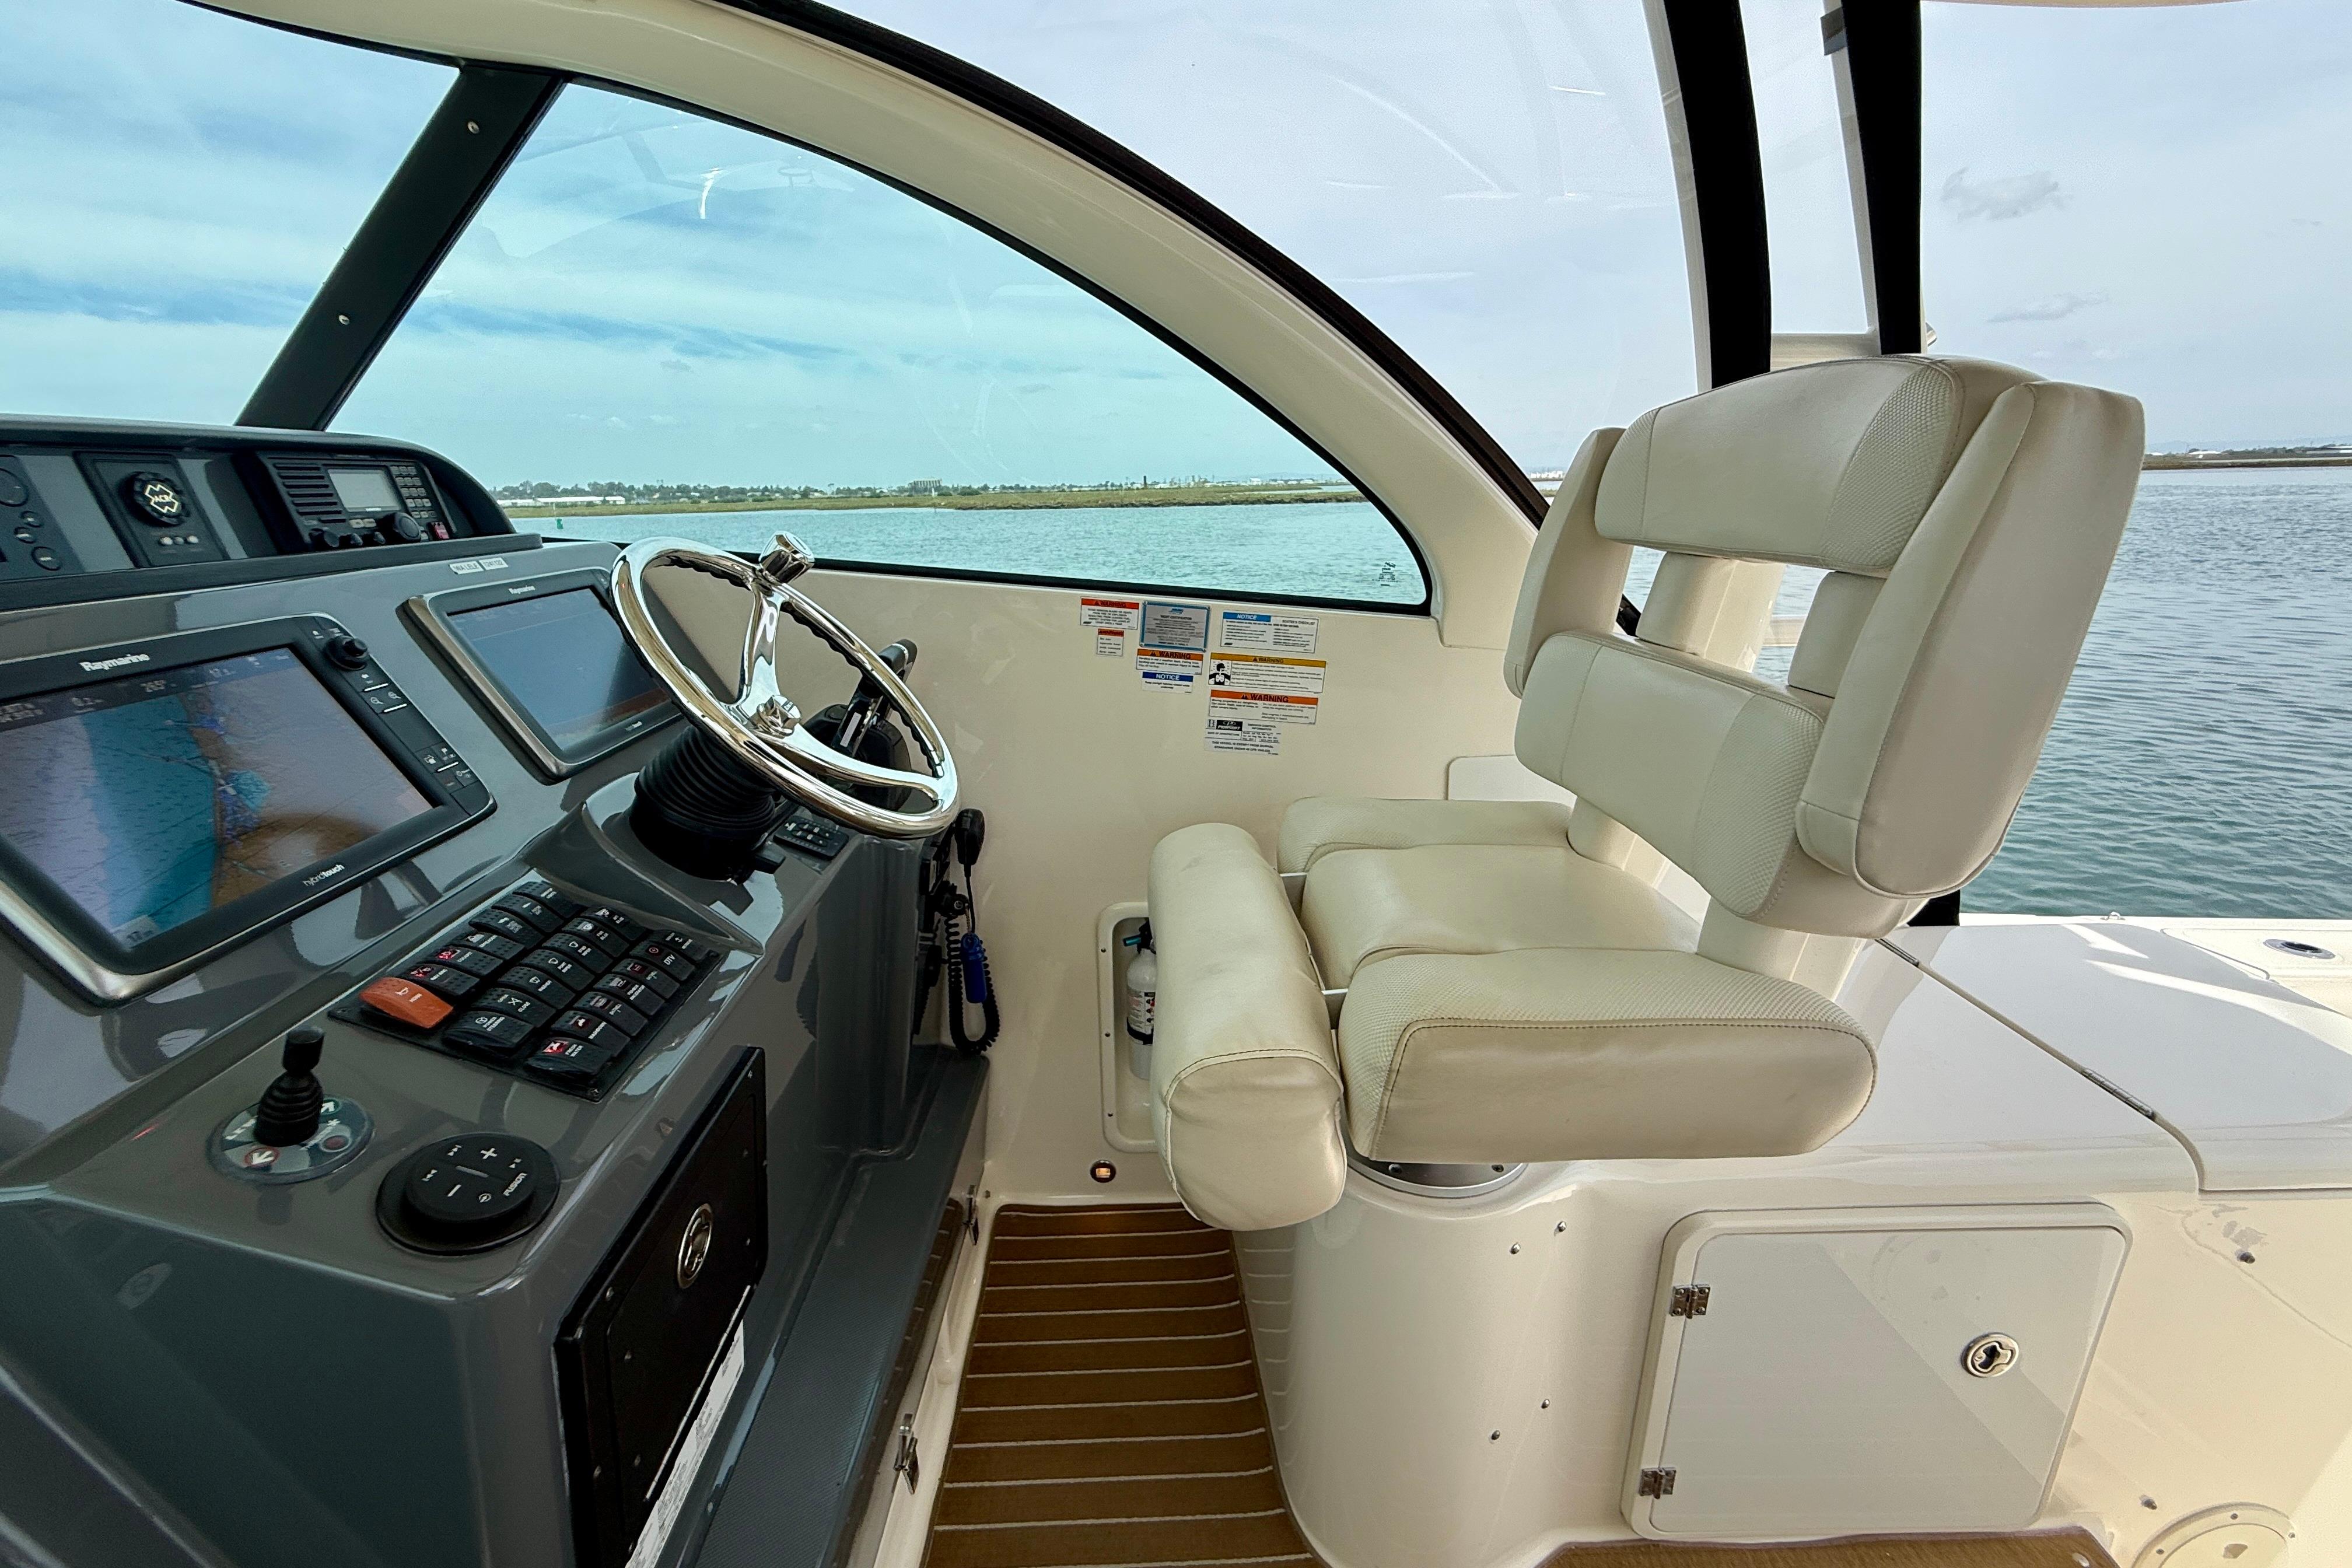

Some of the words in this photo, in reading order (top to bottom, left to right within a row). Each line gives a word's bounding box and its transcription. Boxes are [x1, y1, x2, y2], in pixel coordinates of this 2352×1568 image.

[1158, 650, 1191, 659] WARNING
[79, 653, 150, 671] Raymarine
[1250, 693, 1289, 704] WARNING
[303, 864, 345, 887] hybridtouch
[663, 954, 676, 965] DTV
[410, 993, 422, 1003] HORN
[518, 1001, 531, 1012] CLOSE
[483, 1016, 497, 1028] POWER
[486, 1016, 505, 1031] STEERING
[569, 1045, 584, 1057] WATER
[503, 1172, 527, 1196] FUSION
